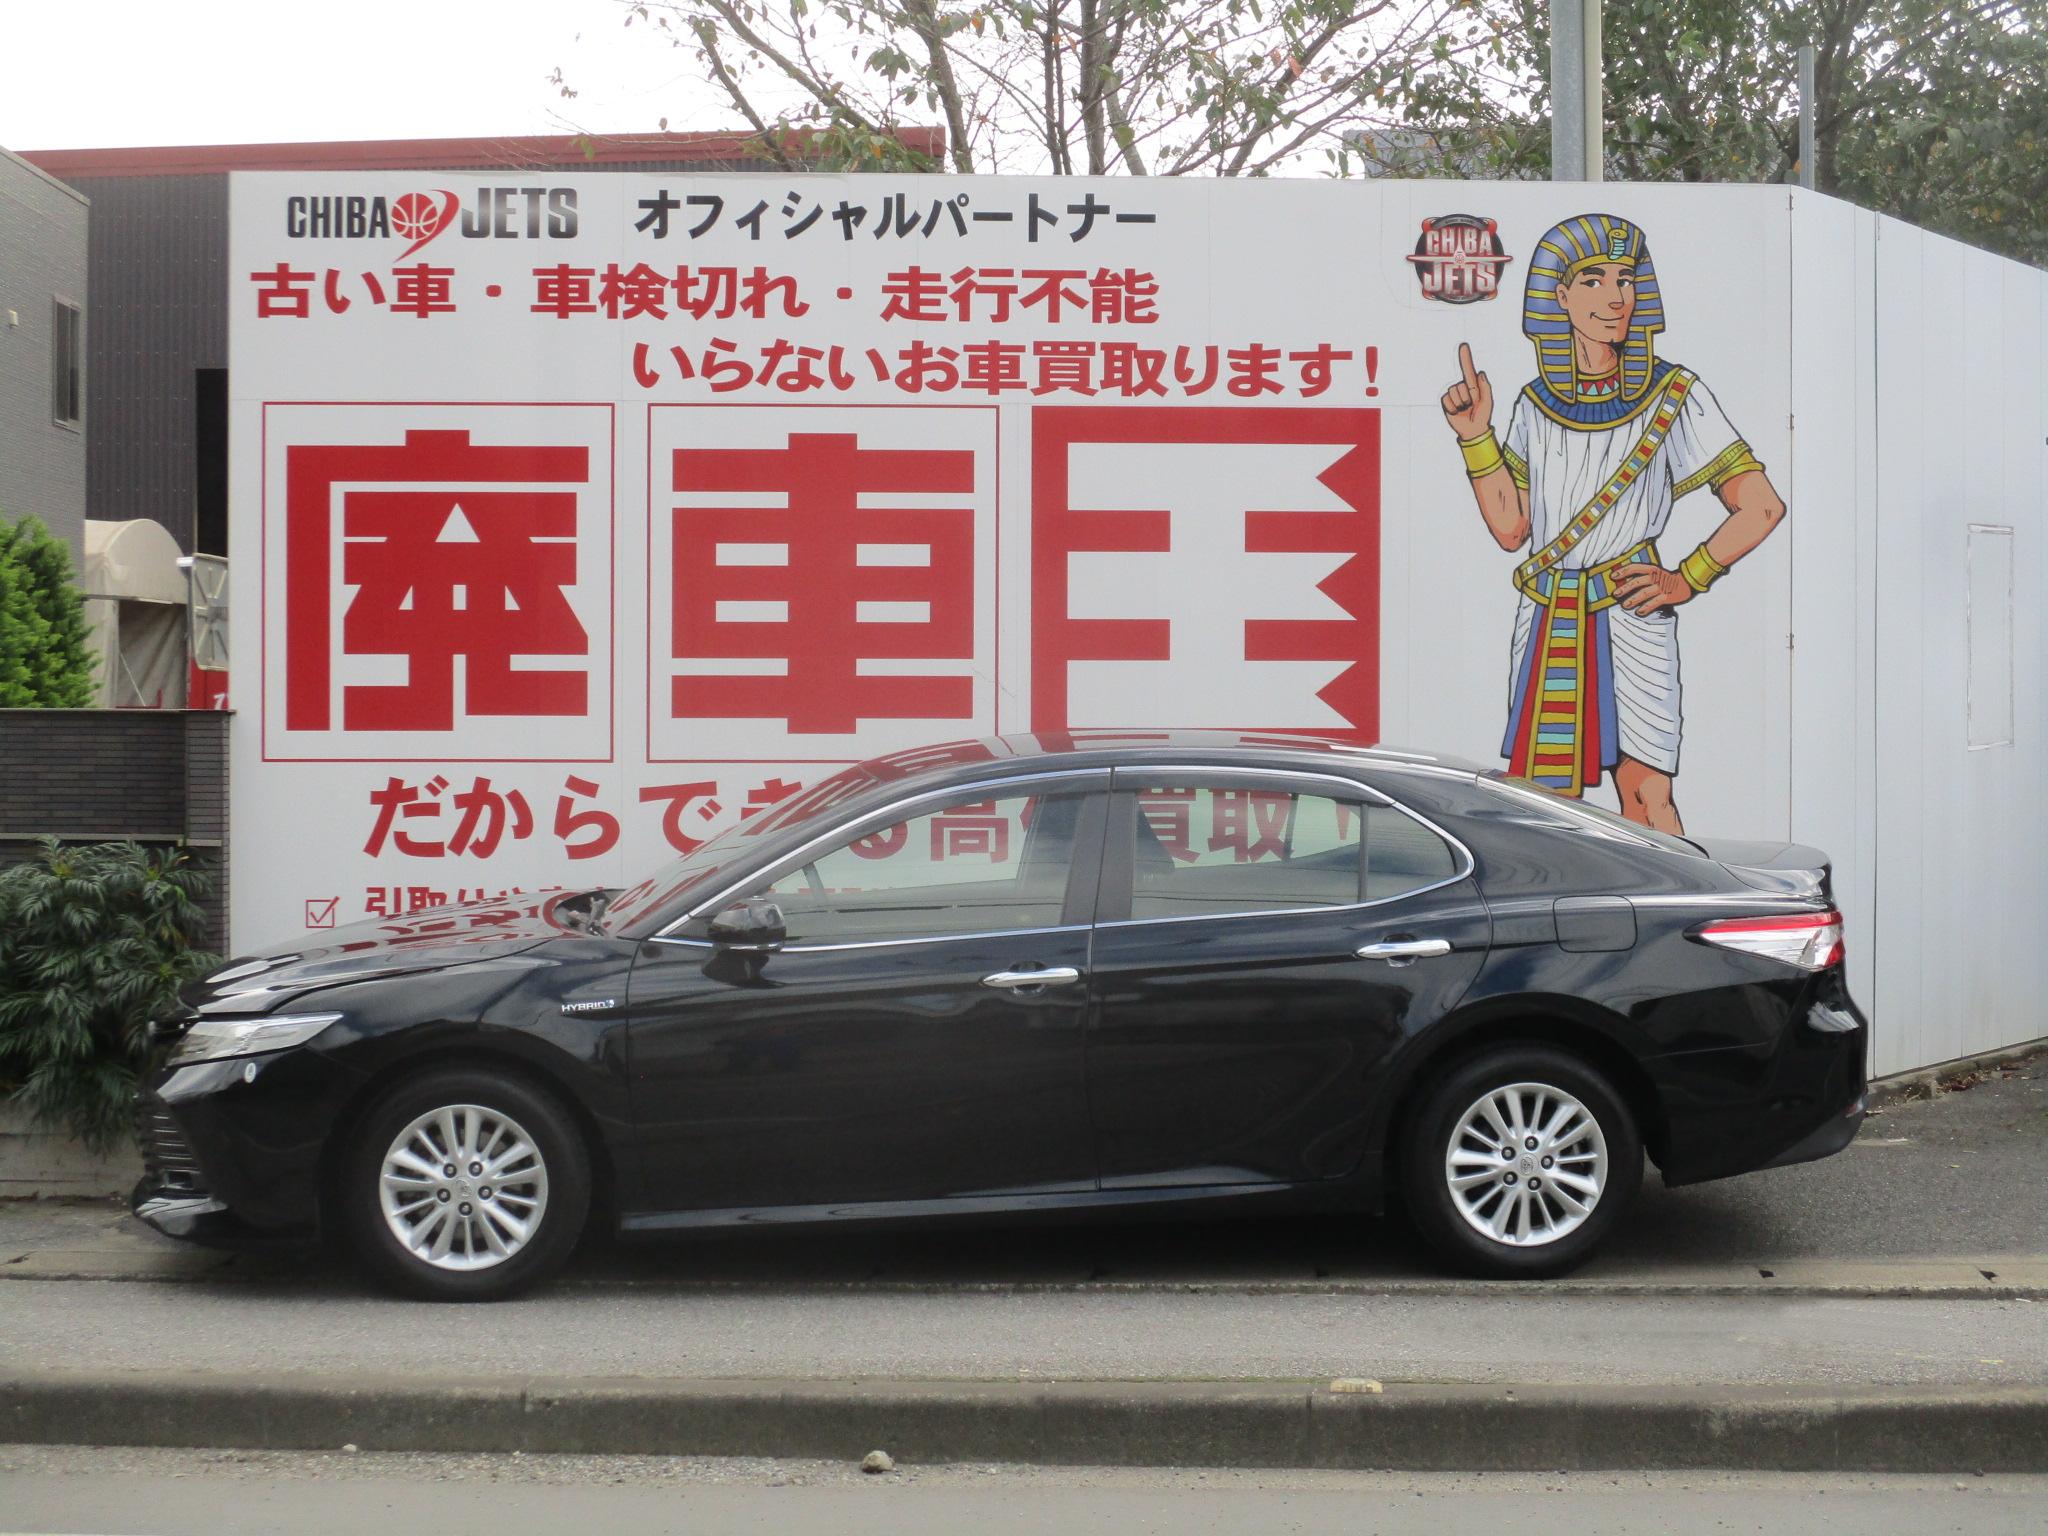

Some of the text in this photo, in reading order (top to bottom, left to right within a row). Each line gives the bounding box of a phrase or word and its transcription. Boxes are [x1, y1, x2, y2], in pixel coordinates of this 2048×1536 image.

[287, 187, 579, 239] CHIBA JETS
[634, 188, 1158, 243] オフィシャルパートナー
[1426, 227, 1493, 256] CHIBA
[250, 262, 1160, 324] 古い車・車検切れ・走行不能
[1423, 261, 1496, 295] JETS
[561, 1000, 607, 1013] HYBRID
